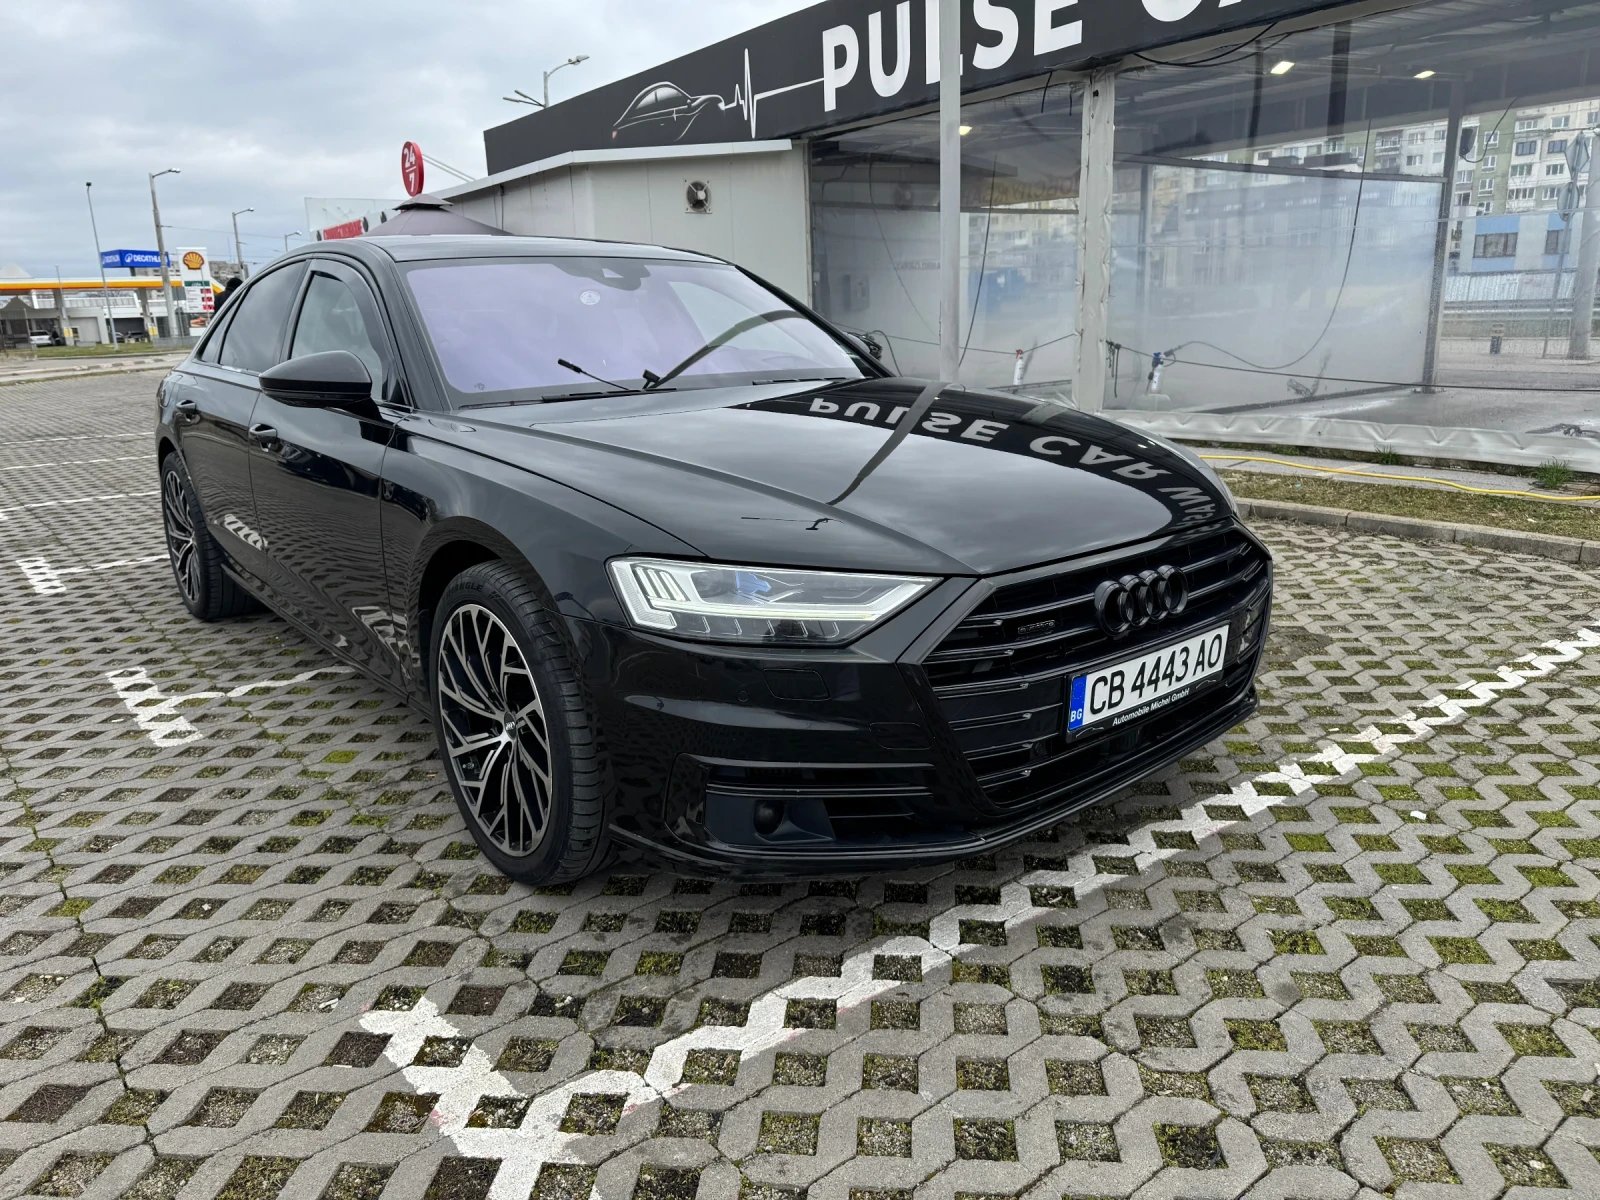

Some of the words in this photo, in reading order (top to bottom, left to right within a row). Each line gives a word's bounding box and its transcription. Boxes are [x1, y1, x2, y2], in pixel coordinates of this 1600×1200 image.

[403, 145, 416, 169] 24
[408, 172, 415, 193] 7
[444, 581, 484, 602] RIANGLE
[1089, 669, 1125, 715] CB
[1130, 645, 1190, 699] 4443
[1192, 633, 1223, 677] AO
[1070, 708, 1083, 723] BG
[1112, 701, 1150, 726] Automobile
[1150, 695, 1171, 711] Michel
[1171, 687, 1190, 703] GmbH
